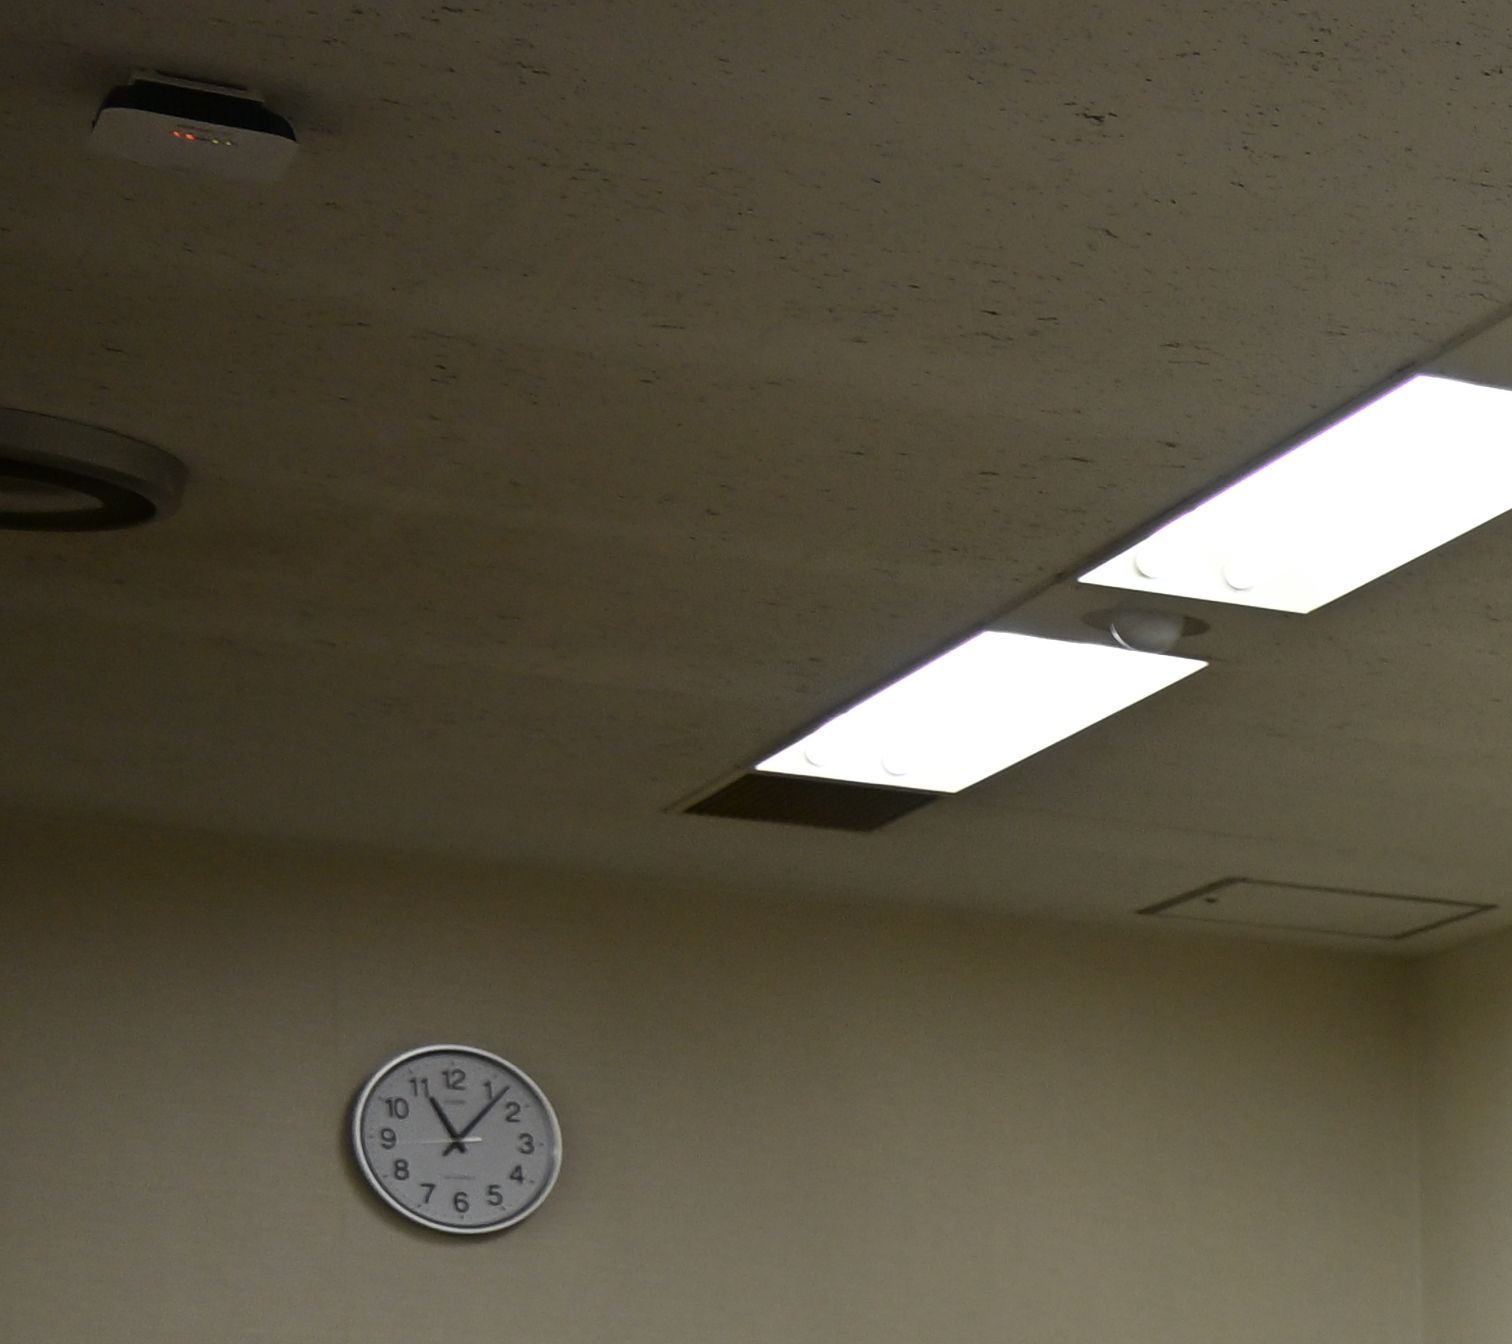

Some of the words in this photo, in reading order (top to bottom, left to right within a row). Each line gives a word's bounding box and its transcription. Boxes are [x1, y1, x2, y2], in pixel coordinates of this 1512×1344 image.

[409, 1077, 430, 1098] 11
[442, 1068, 466, 1091] 12
[484, 1081, 494, 1100] 1
[385, 1097, 409, 1120] 10
[505, 1102, 521, 1123] 2
[380, 1128, 396, 1150] 9
[519, 1133, 535, 1155] 3
[394, 1159, 410, 1181] 8
[509, 1165, 524, 1184] 4
[420, 1183, 436, 1204] 7
[453, 1192, 470, 1213] 6
[487, 1184, 504, 1206] 5
